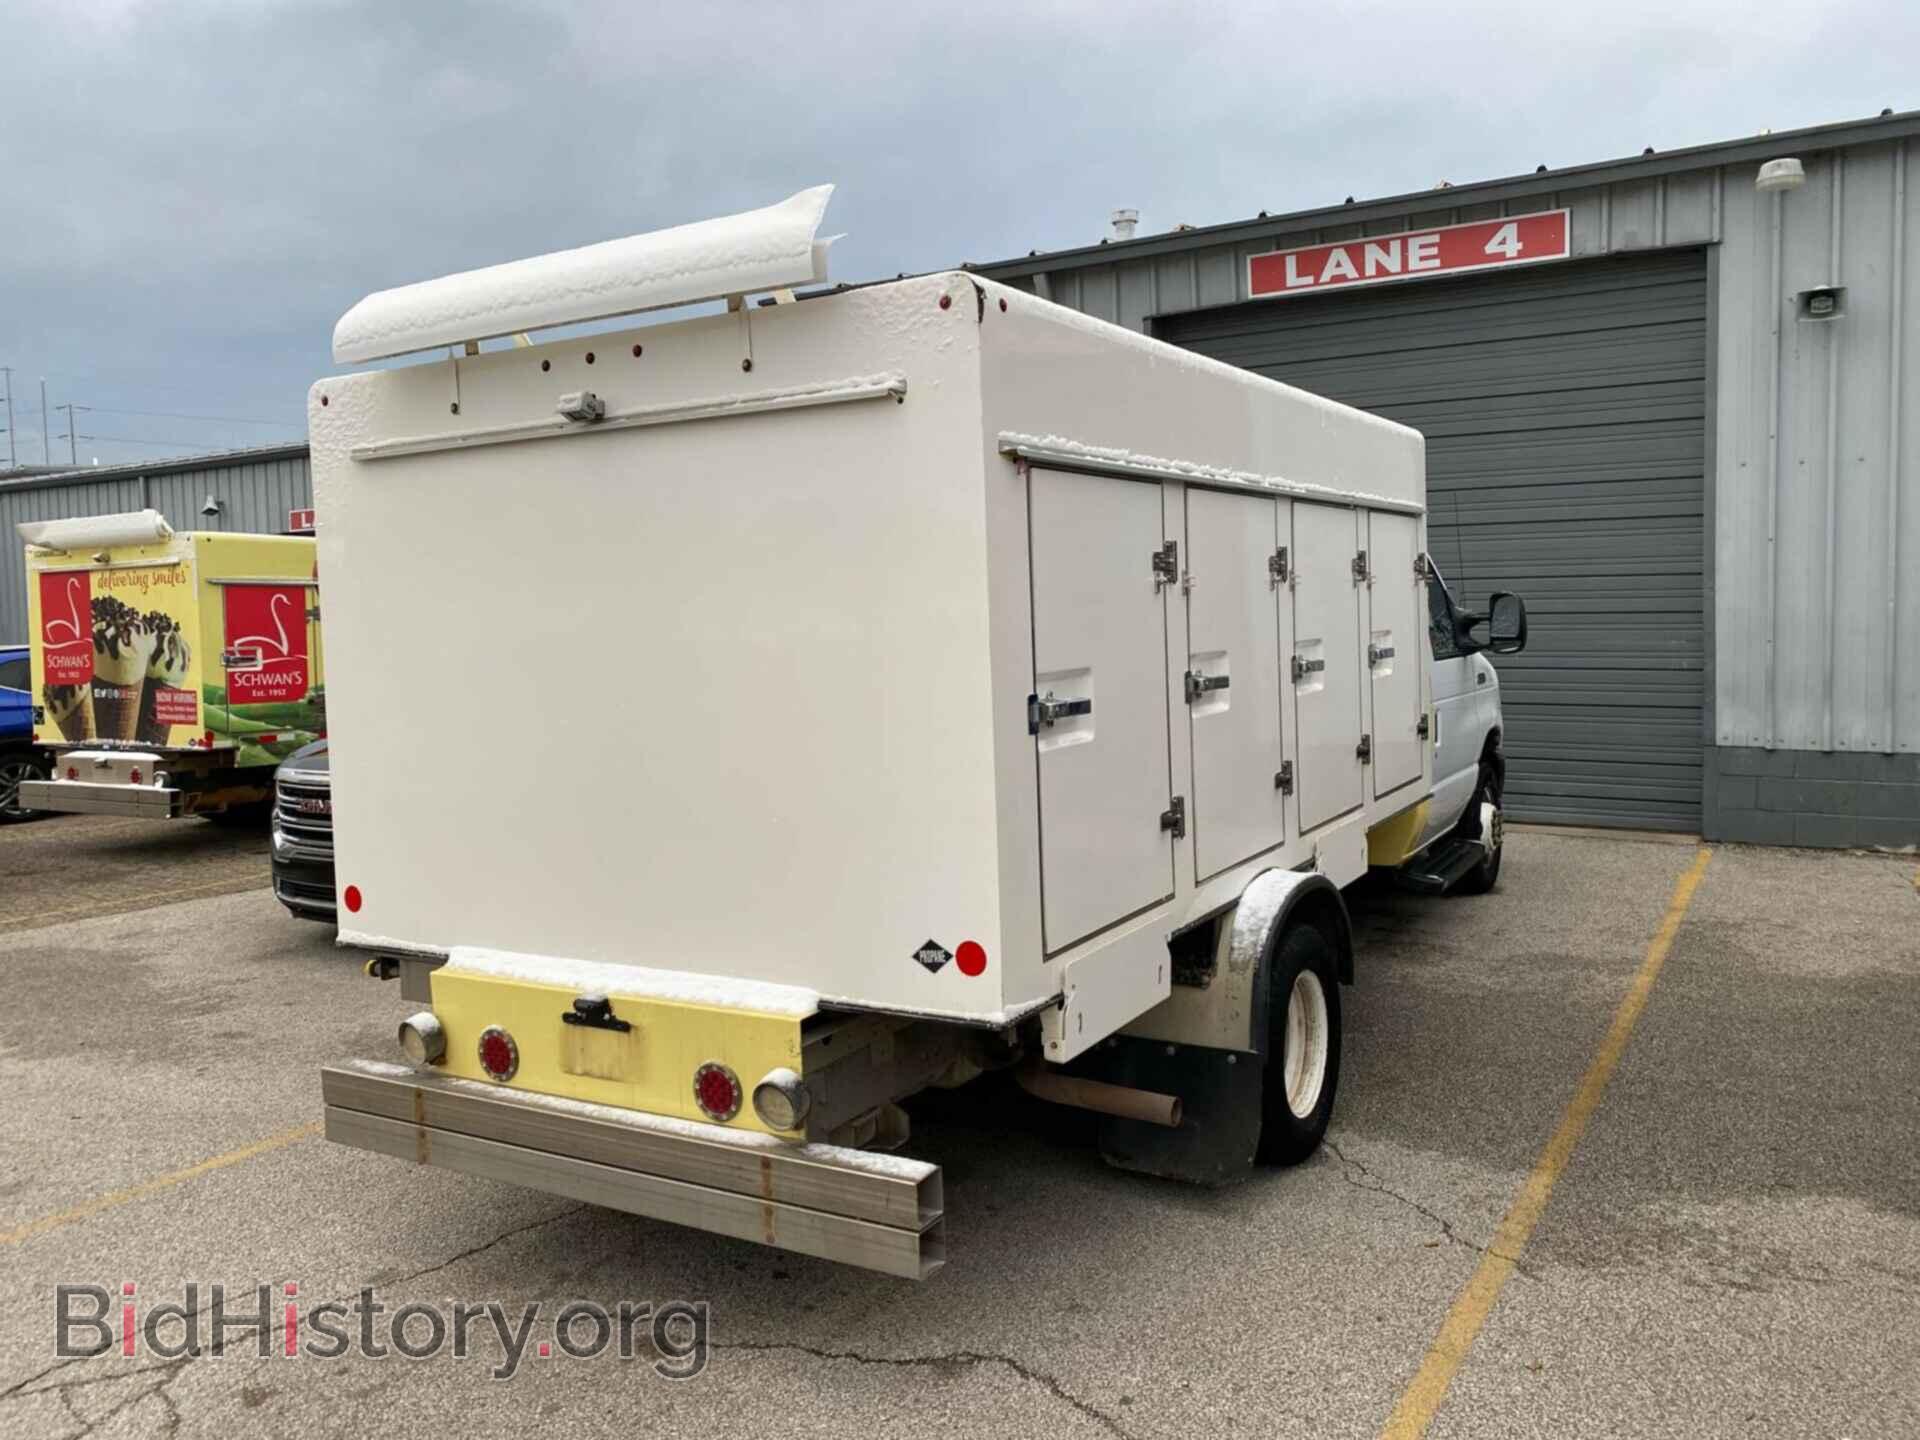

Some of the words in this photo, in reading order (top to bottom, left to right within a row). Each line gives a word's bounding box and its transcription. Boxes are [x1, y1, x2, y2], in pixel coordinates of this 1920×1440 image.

[1285, 233, 1440, 289] LANE
[1483, 222, 1523, 259] 4
[301, 512, 314, 528] L
[97, 569, 149, 595] delivering
[152, 565, 186, 587] smiles
[47, 653, 91, 669] SCHWAN'S
[234, 671, 303, 688] SCHWAN'S
